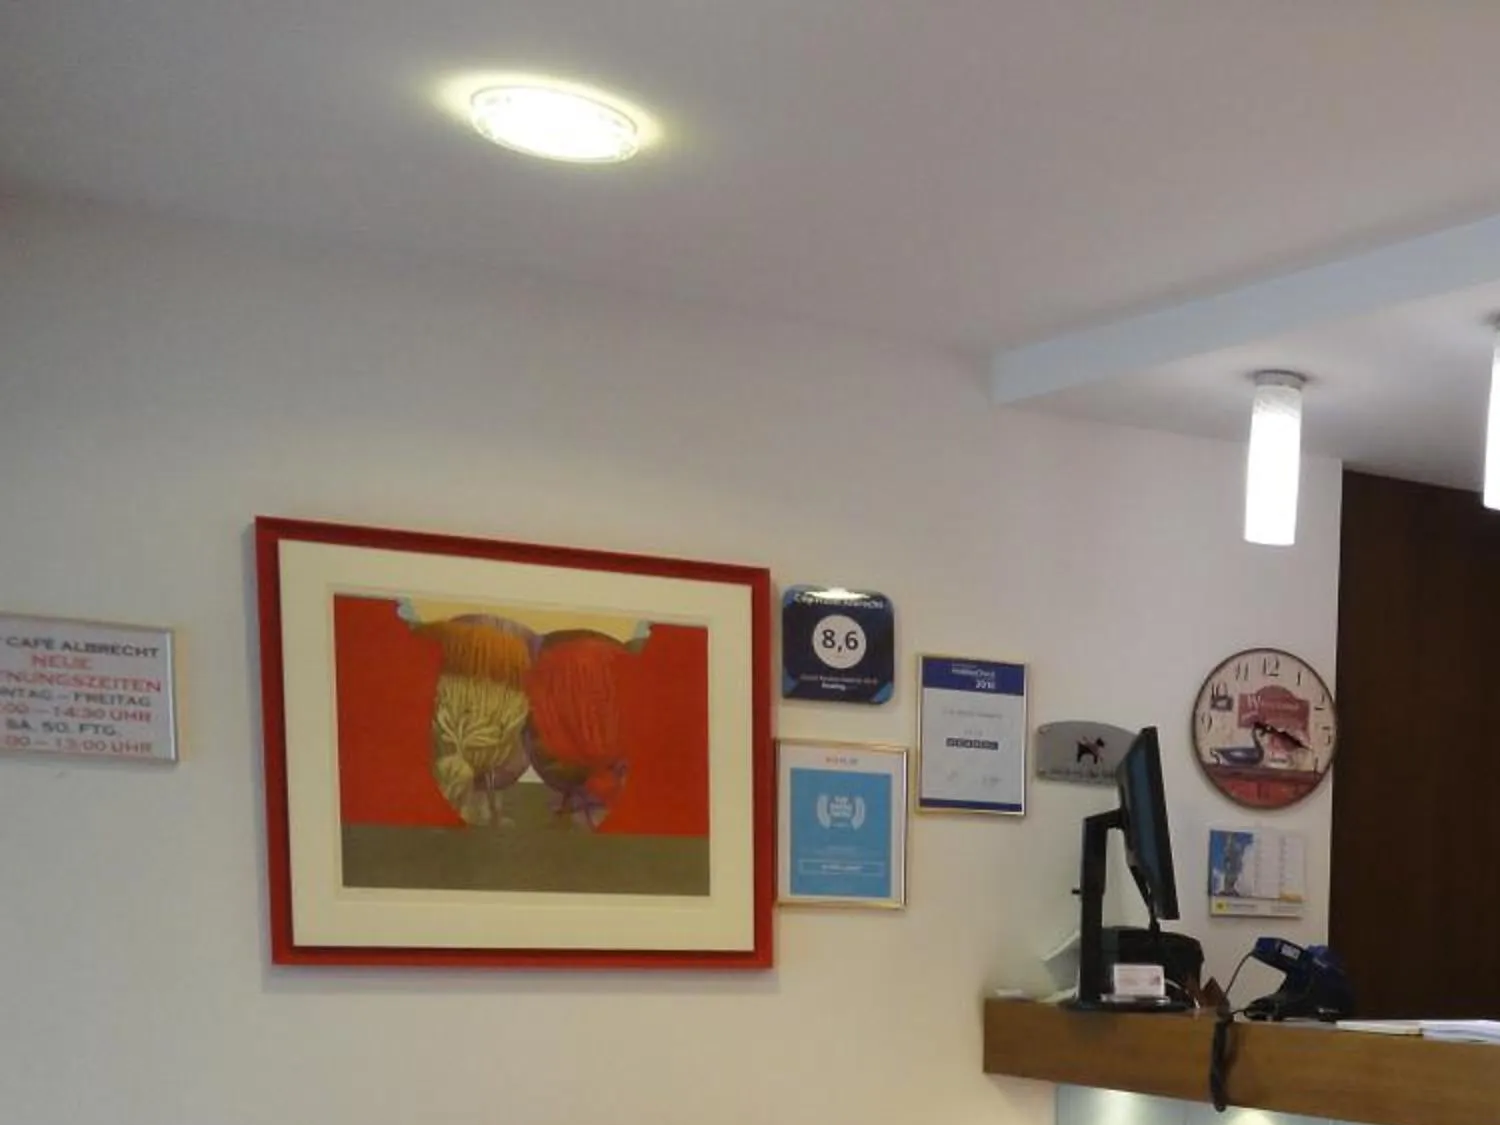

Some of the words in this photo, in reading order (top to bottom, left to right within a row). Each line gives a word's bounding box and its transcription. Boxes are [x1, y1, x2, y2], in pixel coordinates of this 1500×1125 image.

[60, 640, 161, 658] ALBRECHT
[822, 629, 858, 653] 8,6
[31, 654, 93, 670] NEUE
[1262, 656, 1281, 677] 12
[74, 692, 152, 708] FREITAG
[109, 708, 152, 722] UHR
